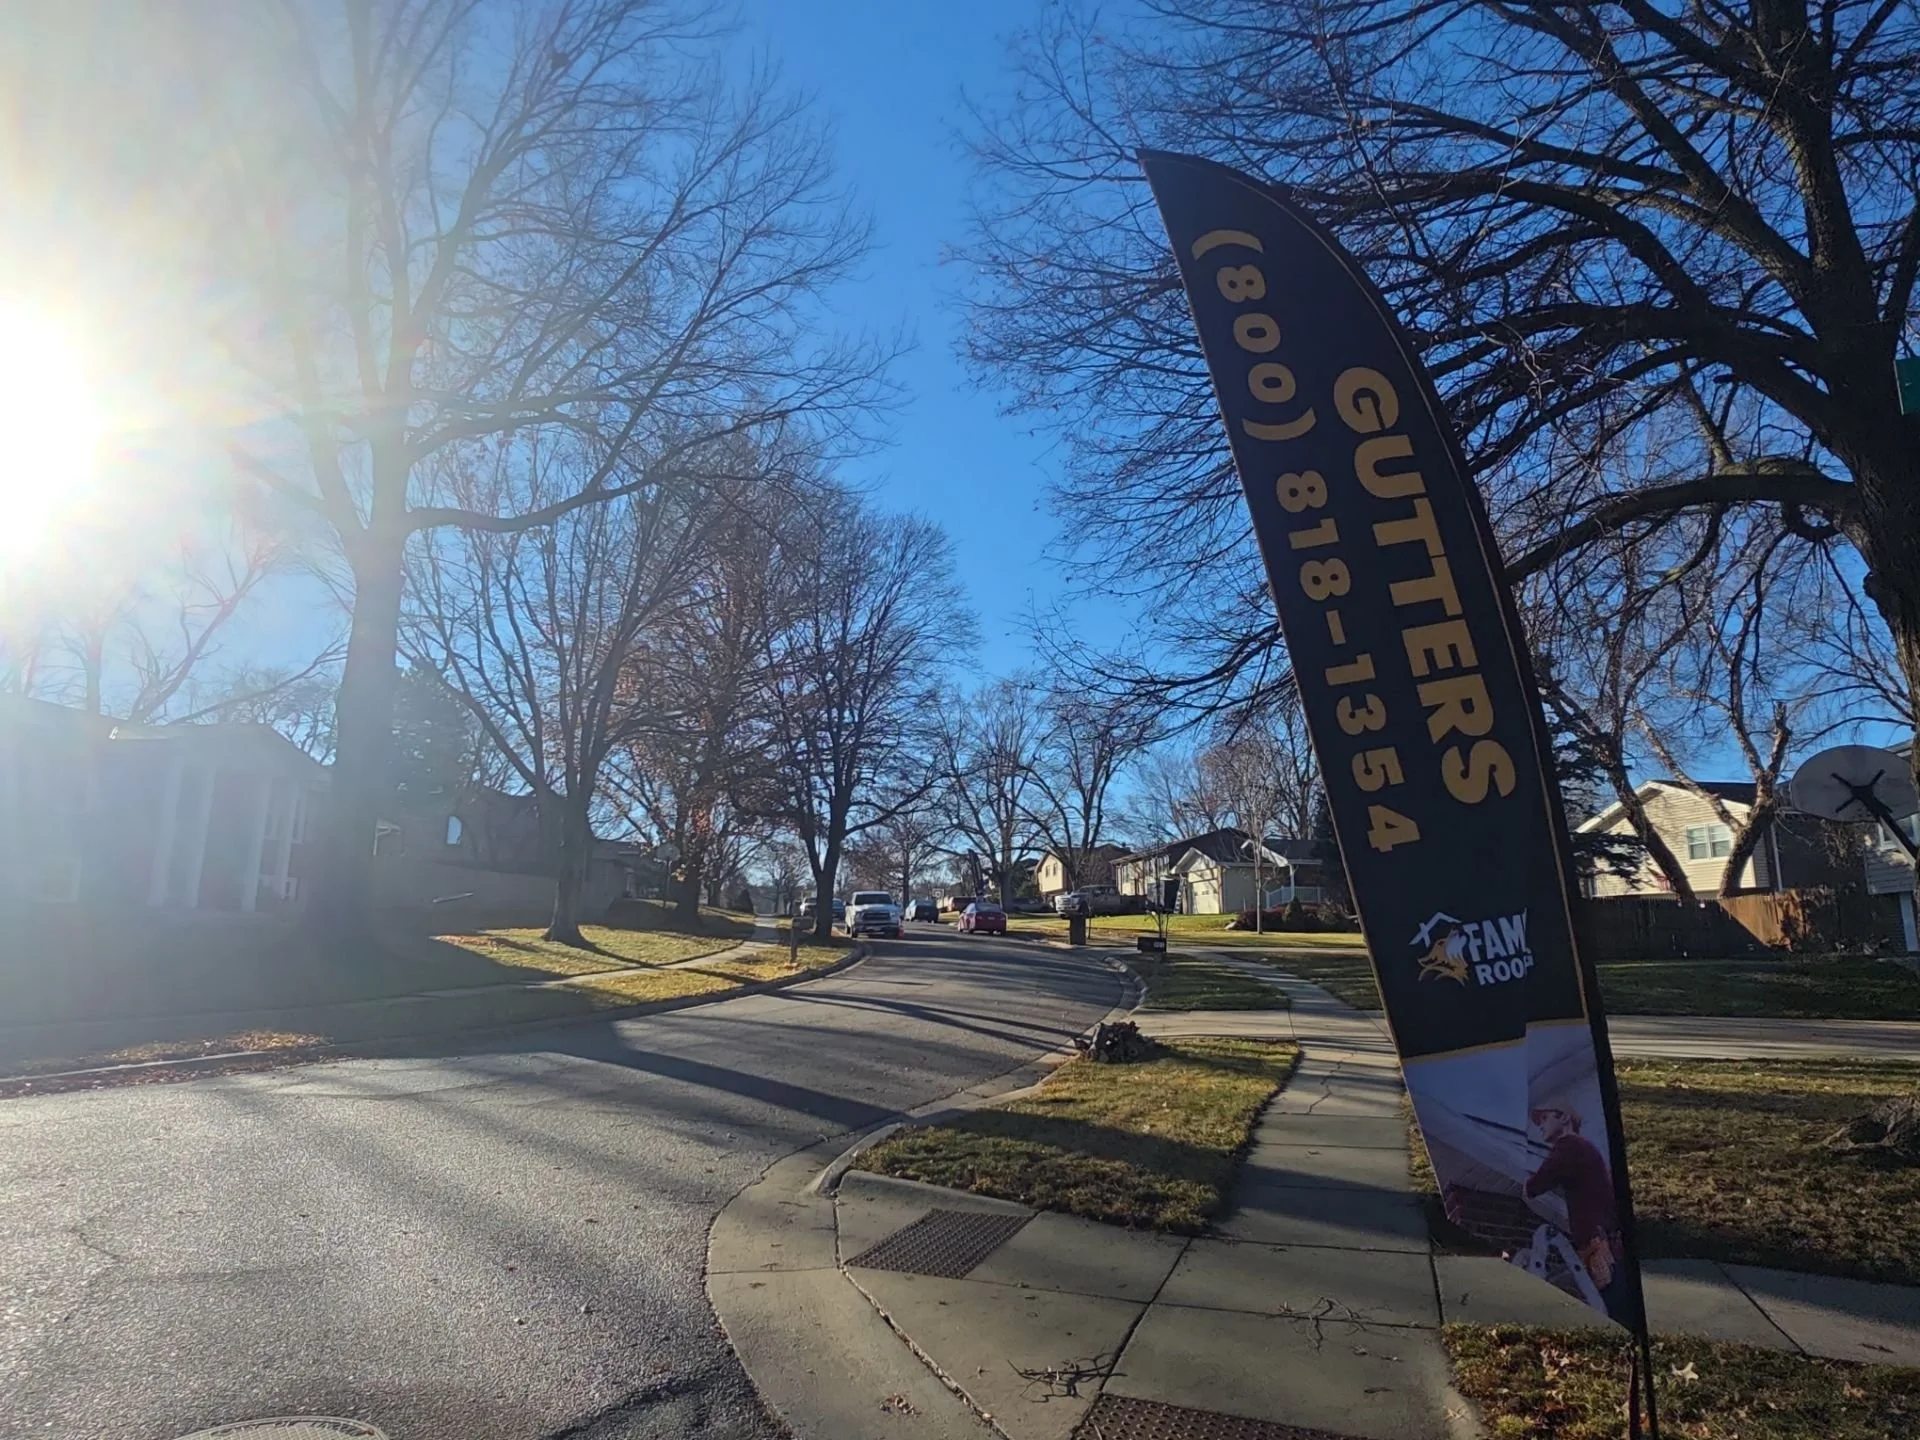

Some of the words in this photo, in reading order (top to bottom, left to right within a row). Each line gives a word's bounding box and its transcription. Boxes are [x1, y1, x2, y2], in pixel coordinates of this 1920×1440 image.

[1191, 228, 1317, 442] (800)
[1276, 469, 1420, 853] 818-1354
[1333, 366, 1516, 804] GUTTERS
[1462, 907, 1527, 962] FAM
